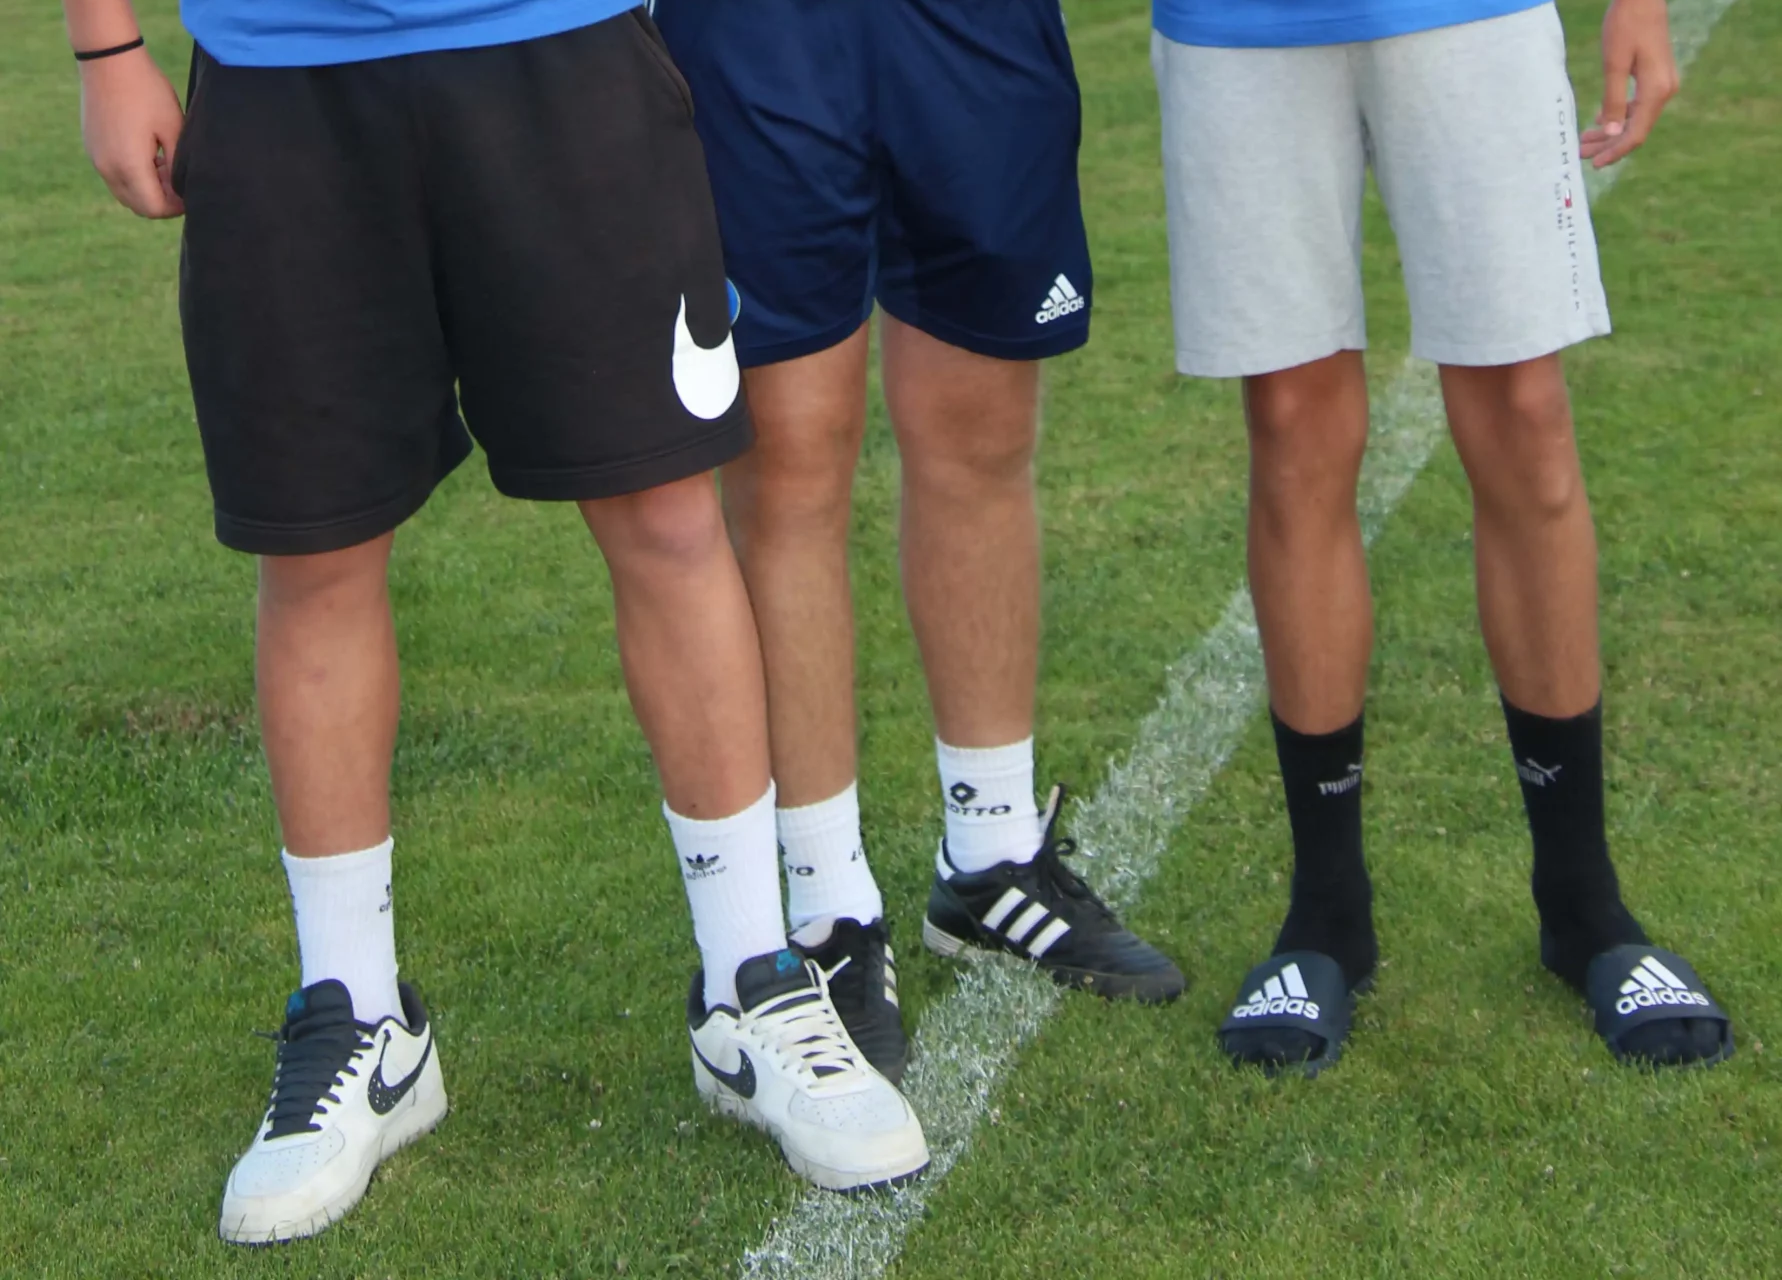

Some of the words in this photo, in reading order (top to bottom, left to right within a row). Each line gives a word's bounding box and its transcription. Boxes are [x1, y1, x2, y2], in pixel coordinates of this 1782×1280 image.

[1035, 295, 1085, 324] adidas
[1232, 995, 1320, 1020] adidas
[1614, 986, 1710, 1015] adidas
